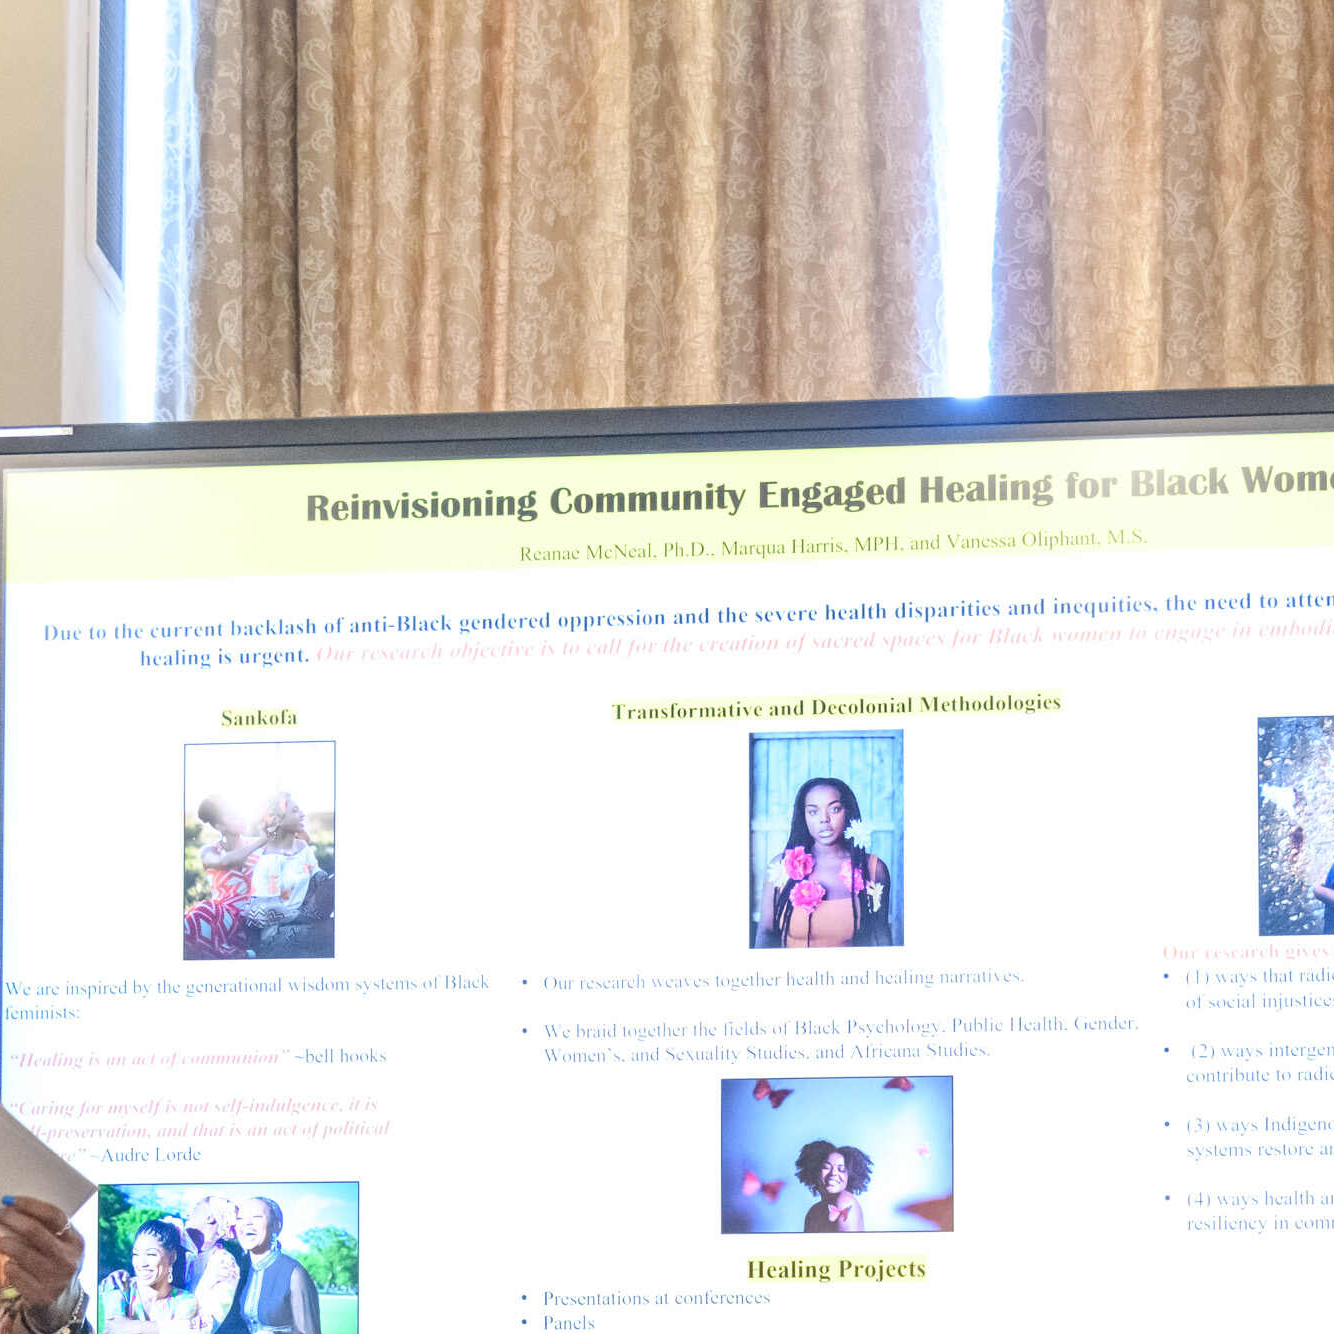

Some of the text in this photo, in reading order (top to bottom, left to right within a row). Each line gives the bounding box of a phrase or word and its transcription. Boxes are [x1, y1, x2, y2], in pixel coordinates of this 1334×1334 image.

[307, 490, 538, 523] Reinvisioning
[550, 482, 746, 516] Community
[758, 475, 906, 514] Engaged
[919, 472, 1053, 508] Healing
[1066, 472, 1117, 499] for
[1131, 467, 1229, 498] Black
[45, 624, 81, 641] Due
[89, 626, 106, 640] to
[115, 623, 143, 640] the
[151, 623, 222, 639] current
[231, 618, 315, 636] backlash
[324, 616, 344, 634] of
[350, 614, 451, 634] anti-Black
[460, 612, 550, 635] gendered
[558, 608, 665, 633] oppression
[674, 608, 709, 625] and
[717, 606, 747, 625] the
[755, 608, 817, 624] severe
[825, 602, 886, 621] health
[895, 599, 1000, 623] disparities
[1008, 598, 1044, 616] and
[1167, 594, 1196, 611] the
[1205, 592, 1250, 611] need
[1260, 595, 1278, 609] to
[140, 647, 210, 668] healing
[218, 647, 231, 663] is
[612, 692, 1061, 721] Transformative and Decolonial Methodologies
[221, 708, 297, 727] Sankofa
[540, 975, 574, 992] Our
[579, 974, 645, 992] research
[651, 975, 709, 992] weaves
[716, 970, 781, 992] together
[787, 969, 834, 992] health
[841, 968, 870, 985] and
[875, 968, 934, 989] healing
[1186, 967, 1208, 986] (1)
[1215, 972, 1257, 986] ways
[1263, 966, 1292, 982] that
[5, 974, 490, 999] We are inspired by the generational wisdom systems of Black
[1209, 992, 1255, 1009] social
[5, 1004, 81, 1020] feminists:
[577, 1021, 616, 1036] braid
[623, 1021, 688, 1040] together
[693, 1021, 716, 1035] the
[723, 1020, 767, 1035] fields
[795, 1020, 839, 1034] Black
[952, 1018, 1002, 1033] Public
[339, 1048, 387, 1063] hooks
[631, 1047, 659, 1065] and
[666, 1044, 739, 1065] Sexuality
[816, 1043, 843, 1060] and
[851, 1043, 920, 1059] Africana
[1192, 1043, 1215, 1059] (2)
[1221, 1047, 1263, 1062] ways
[1187, 1066, 1270, 1084] contribute
[1276, 1069, 1291, 1081] to
[1187, 1117, 1211, 1136] (3)
[1216, 1120, 1259, 1136] ways
[156, 1147, 201, 1162] Lorde
[1187, 1143, 1251, 1161] systems
[1259, 1143, 1314, 1160] restore
[1187, 1189, 1210, 1208] (4)
[1217, 1195, 1258, 1208] ways
[1265, 1189, 1314, 1205] health
[1187, 1214, 1266, 1233] resiliency
[1273, 1214, 1288, 1230] in
[747, 1259, 926, 1283] Healing Projects
[542, 1289, 770, 1306] Presentations at conferences
[544, 1314, 595, 1331] Panels
